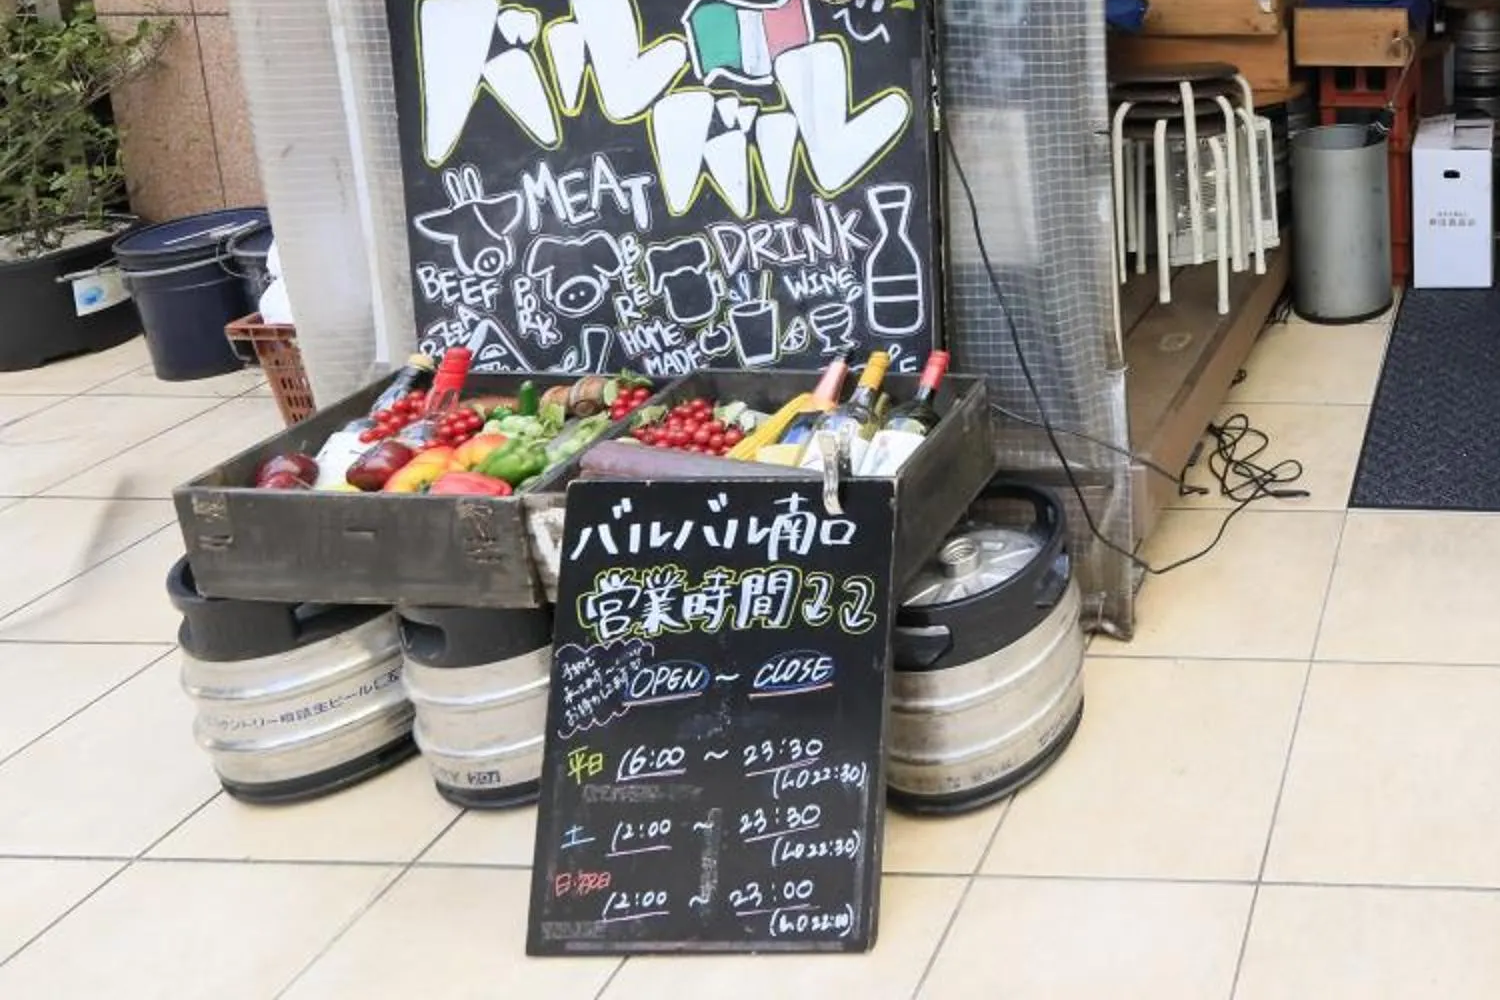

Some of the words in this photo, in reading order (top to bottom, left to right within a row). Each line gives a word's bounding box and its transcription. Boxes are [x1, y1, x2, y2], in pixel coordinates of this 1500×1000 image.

[521, 154, 655, 231] MEAT
[709, 197, 872, 275] DRINK
[416, 265, 503, 309] BEEF
[615, 232, 648, 325] BEER
[782, 266, 857, 301] WINE
[513, 278, 561, 345] PORK
[618, 320, 682, 355] HOME
[643, 340, 706, 376] MADE
[570, 492, 857, 561] バルバル南口
[582, 567, 799, 640] 営業時間
[628, 663, 704, 699] OPEN
[752, 655, 834, 689] CLOSE
[567, 749, 604, 786] 平日
[616, 746, 687, 781] 16:00
[742, 737, 825, 768] 23:30
[611, 819, 673, 852] 12:00
[738, 803, 822, 834] 23:30
[602, 890, 668, 922] 12:00
[728, 879, 815, 909] 23:00
